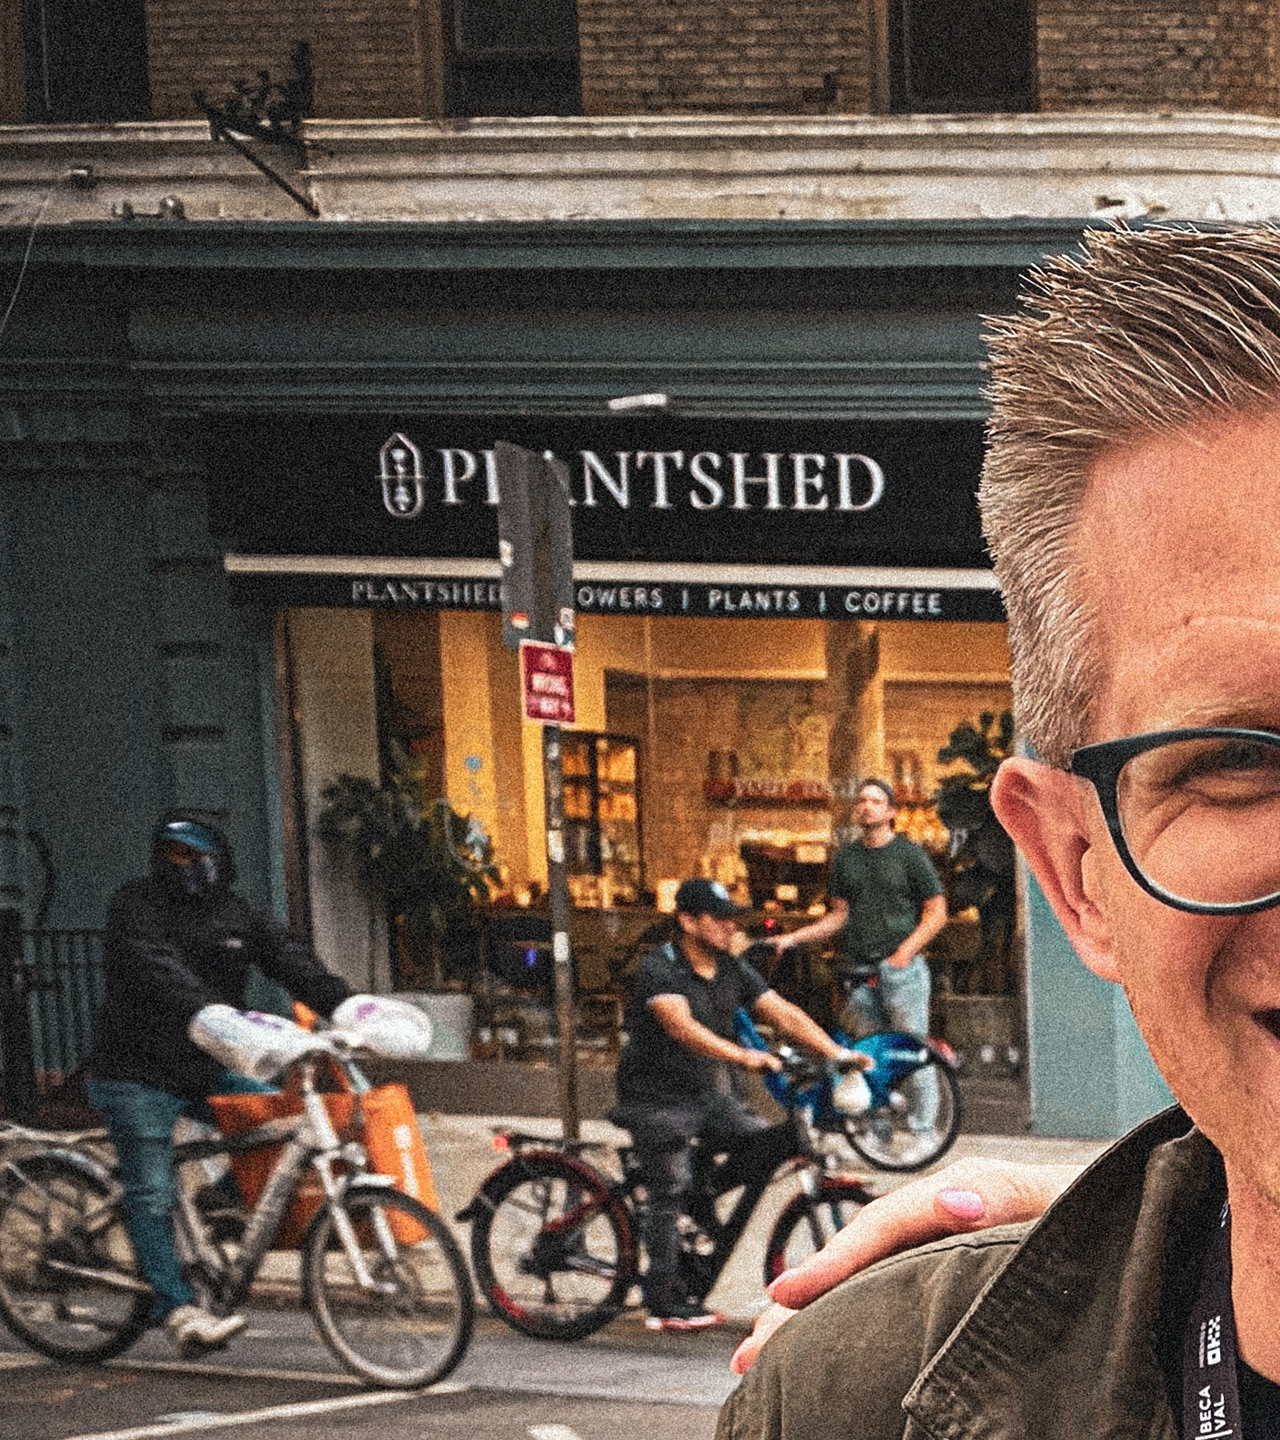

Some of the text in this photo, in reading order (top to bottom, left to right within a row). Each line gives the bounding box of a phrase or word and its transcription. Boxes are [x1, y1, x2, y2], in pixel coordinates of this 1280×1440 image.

[577, 585, 664, 610] OWERS
[707, 588, 801, 612] PLANTS
[844, 590, 943, 615] COFFEE
